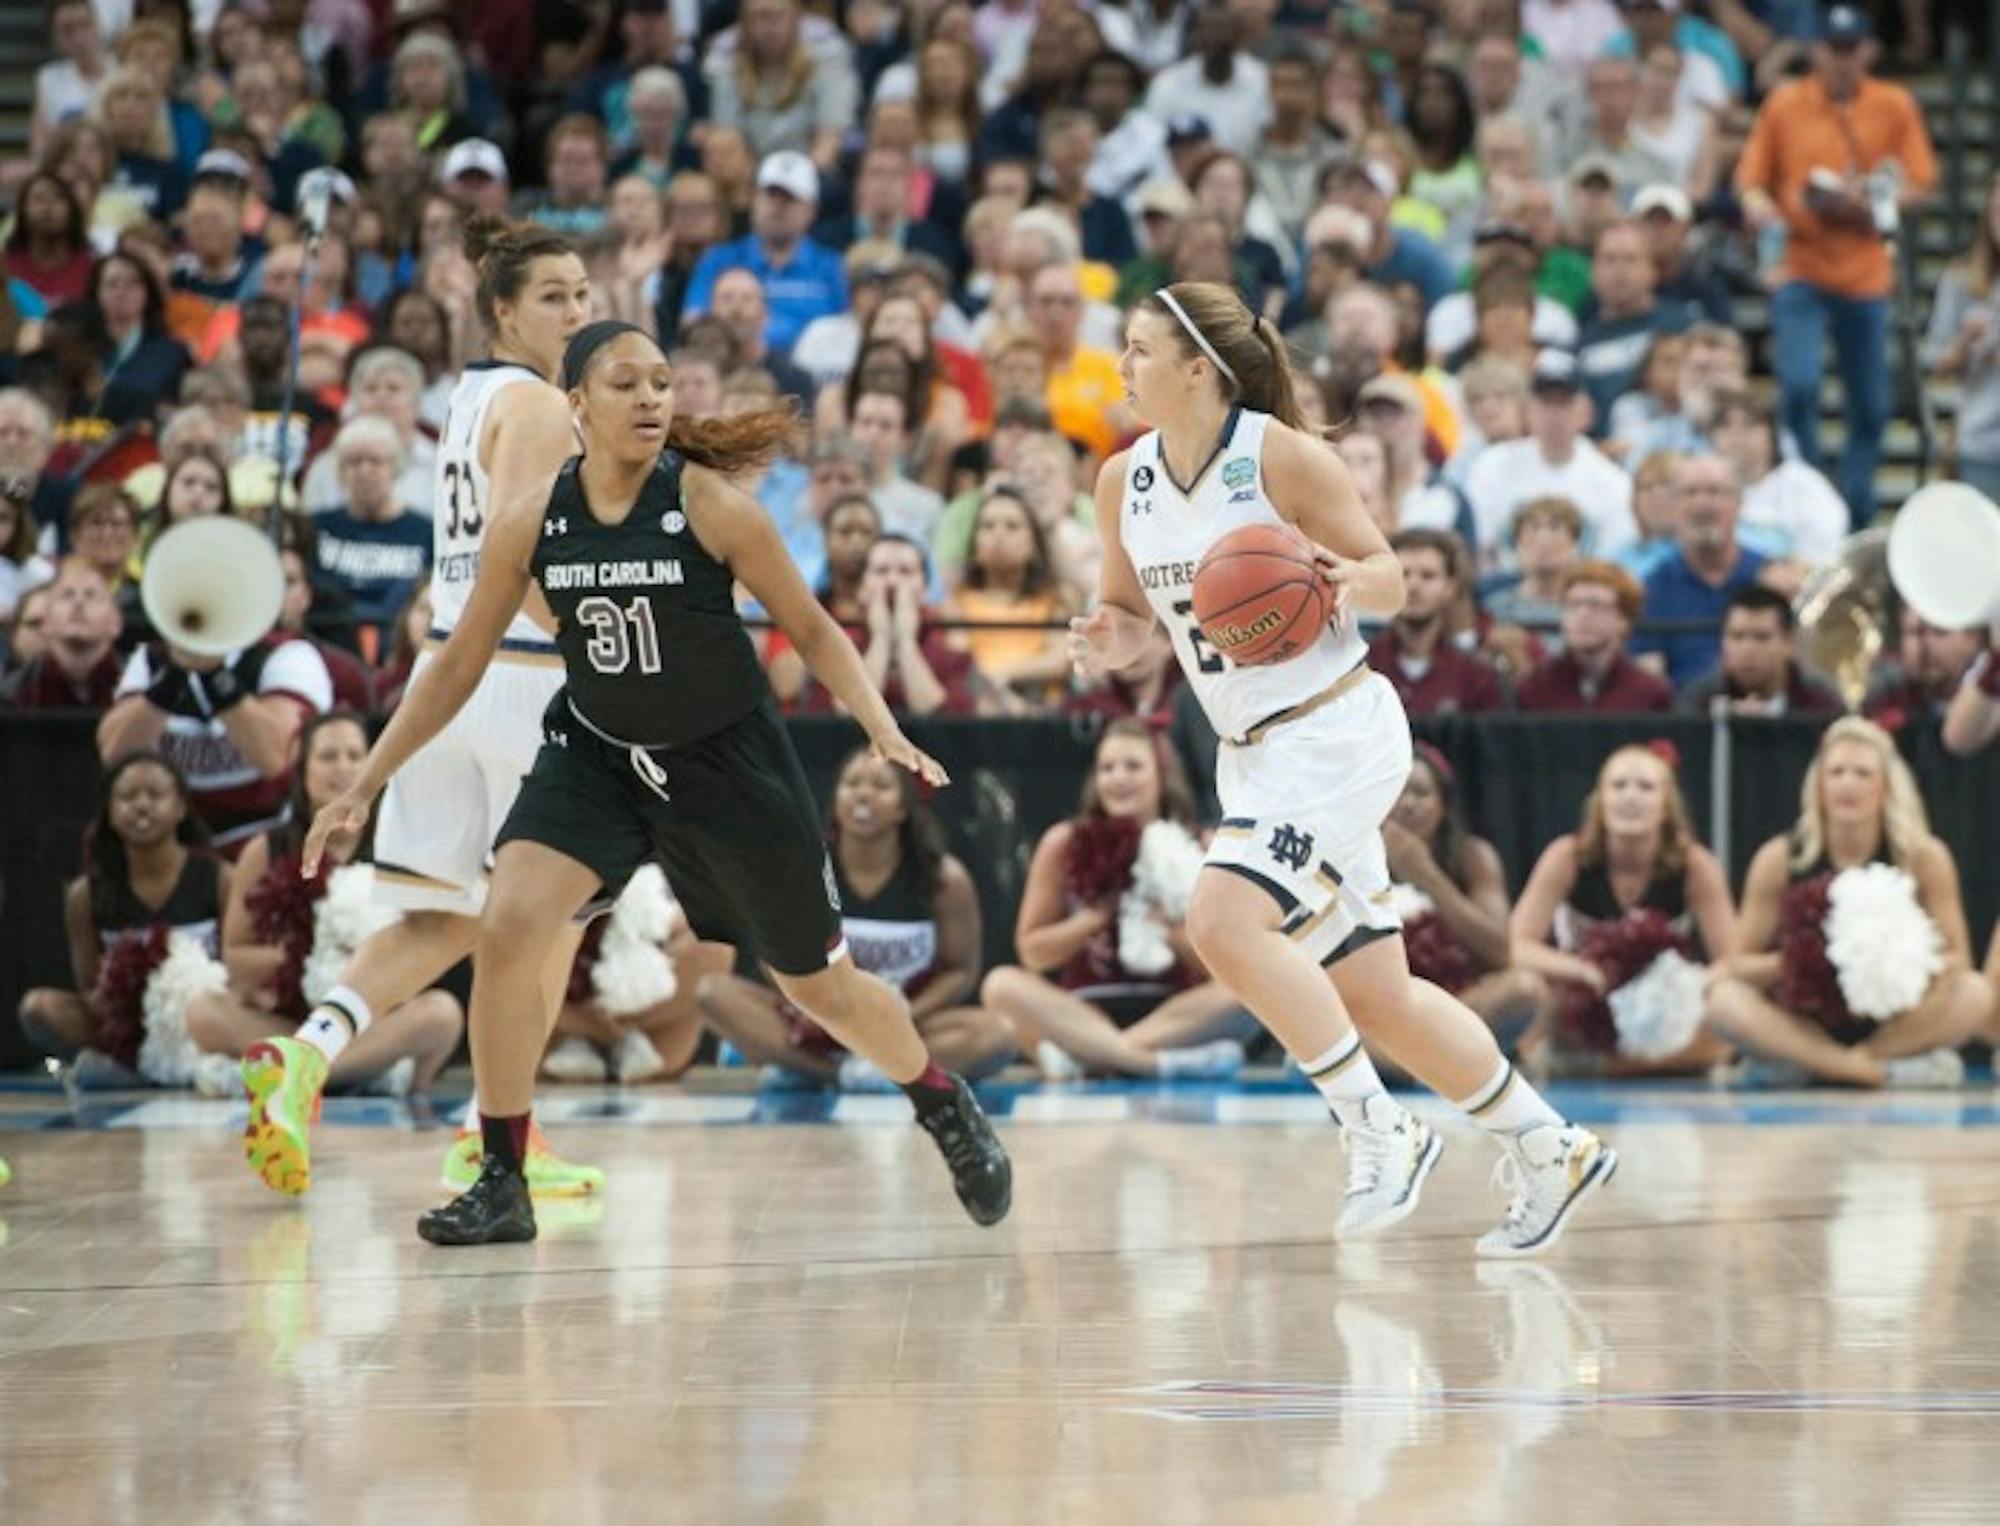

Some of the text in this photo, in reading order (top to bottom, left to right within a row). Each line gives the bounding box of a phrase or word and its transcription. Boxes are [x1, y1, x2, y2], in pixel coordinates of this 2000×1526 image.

[544, 559, 685, 589] SOUTH CAROLINA
[575, 596, 662, 674] 31
